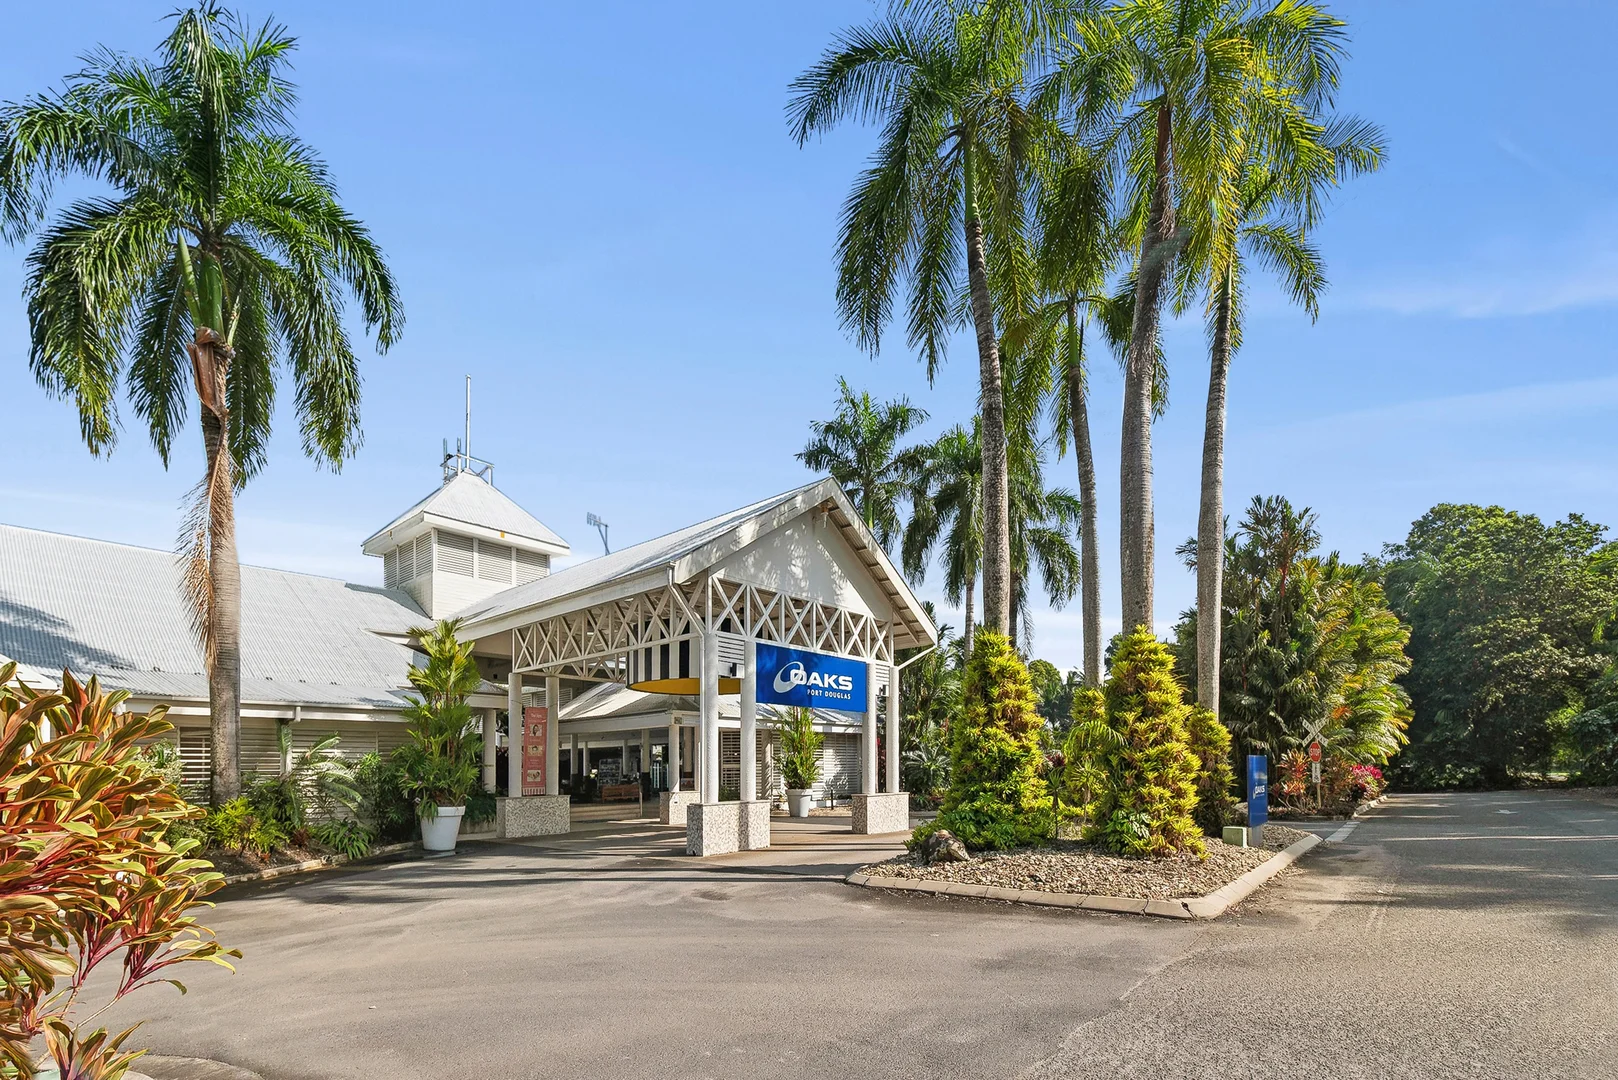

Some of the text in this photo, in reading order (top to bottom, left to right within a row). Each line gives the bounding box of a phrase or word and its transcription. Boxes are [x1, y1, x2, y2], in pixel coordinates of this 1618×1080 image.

[790, 669, 852, 691] OAKS
[807, 689, 851, 700] PORT DOUGLAS
[1309, 748, 1320, 756] STOP
